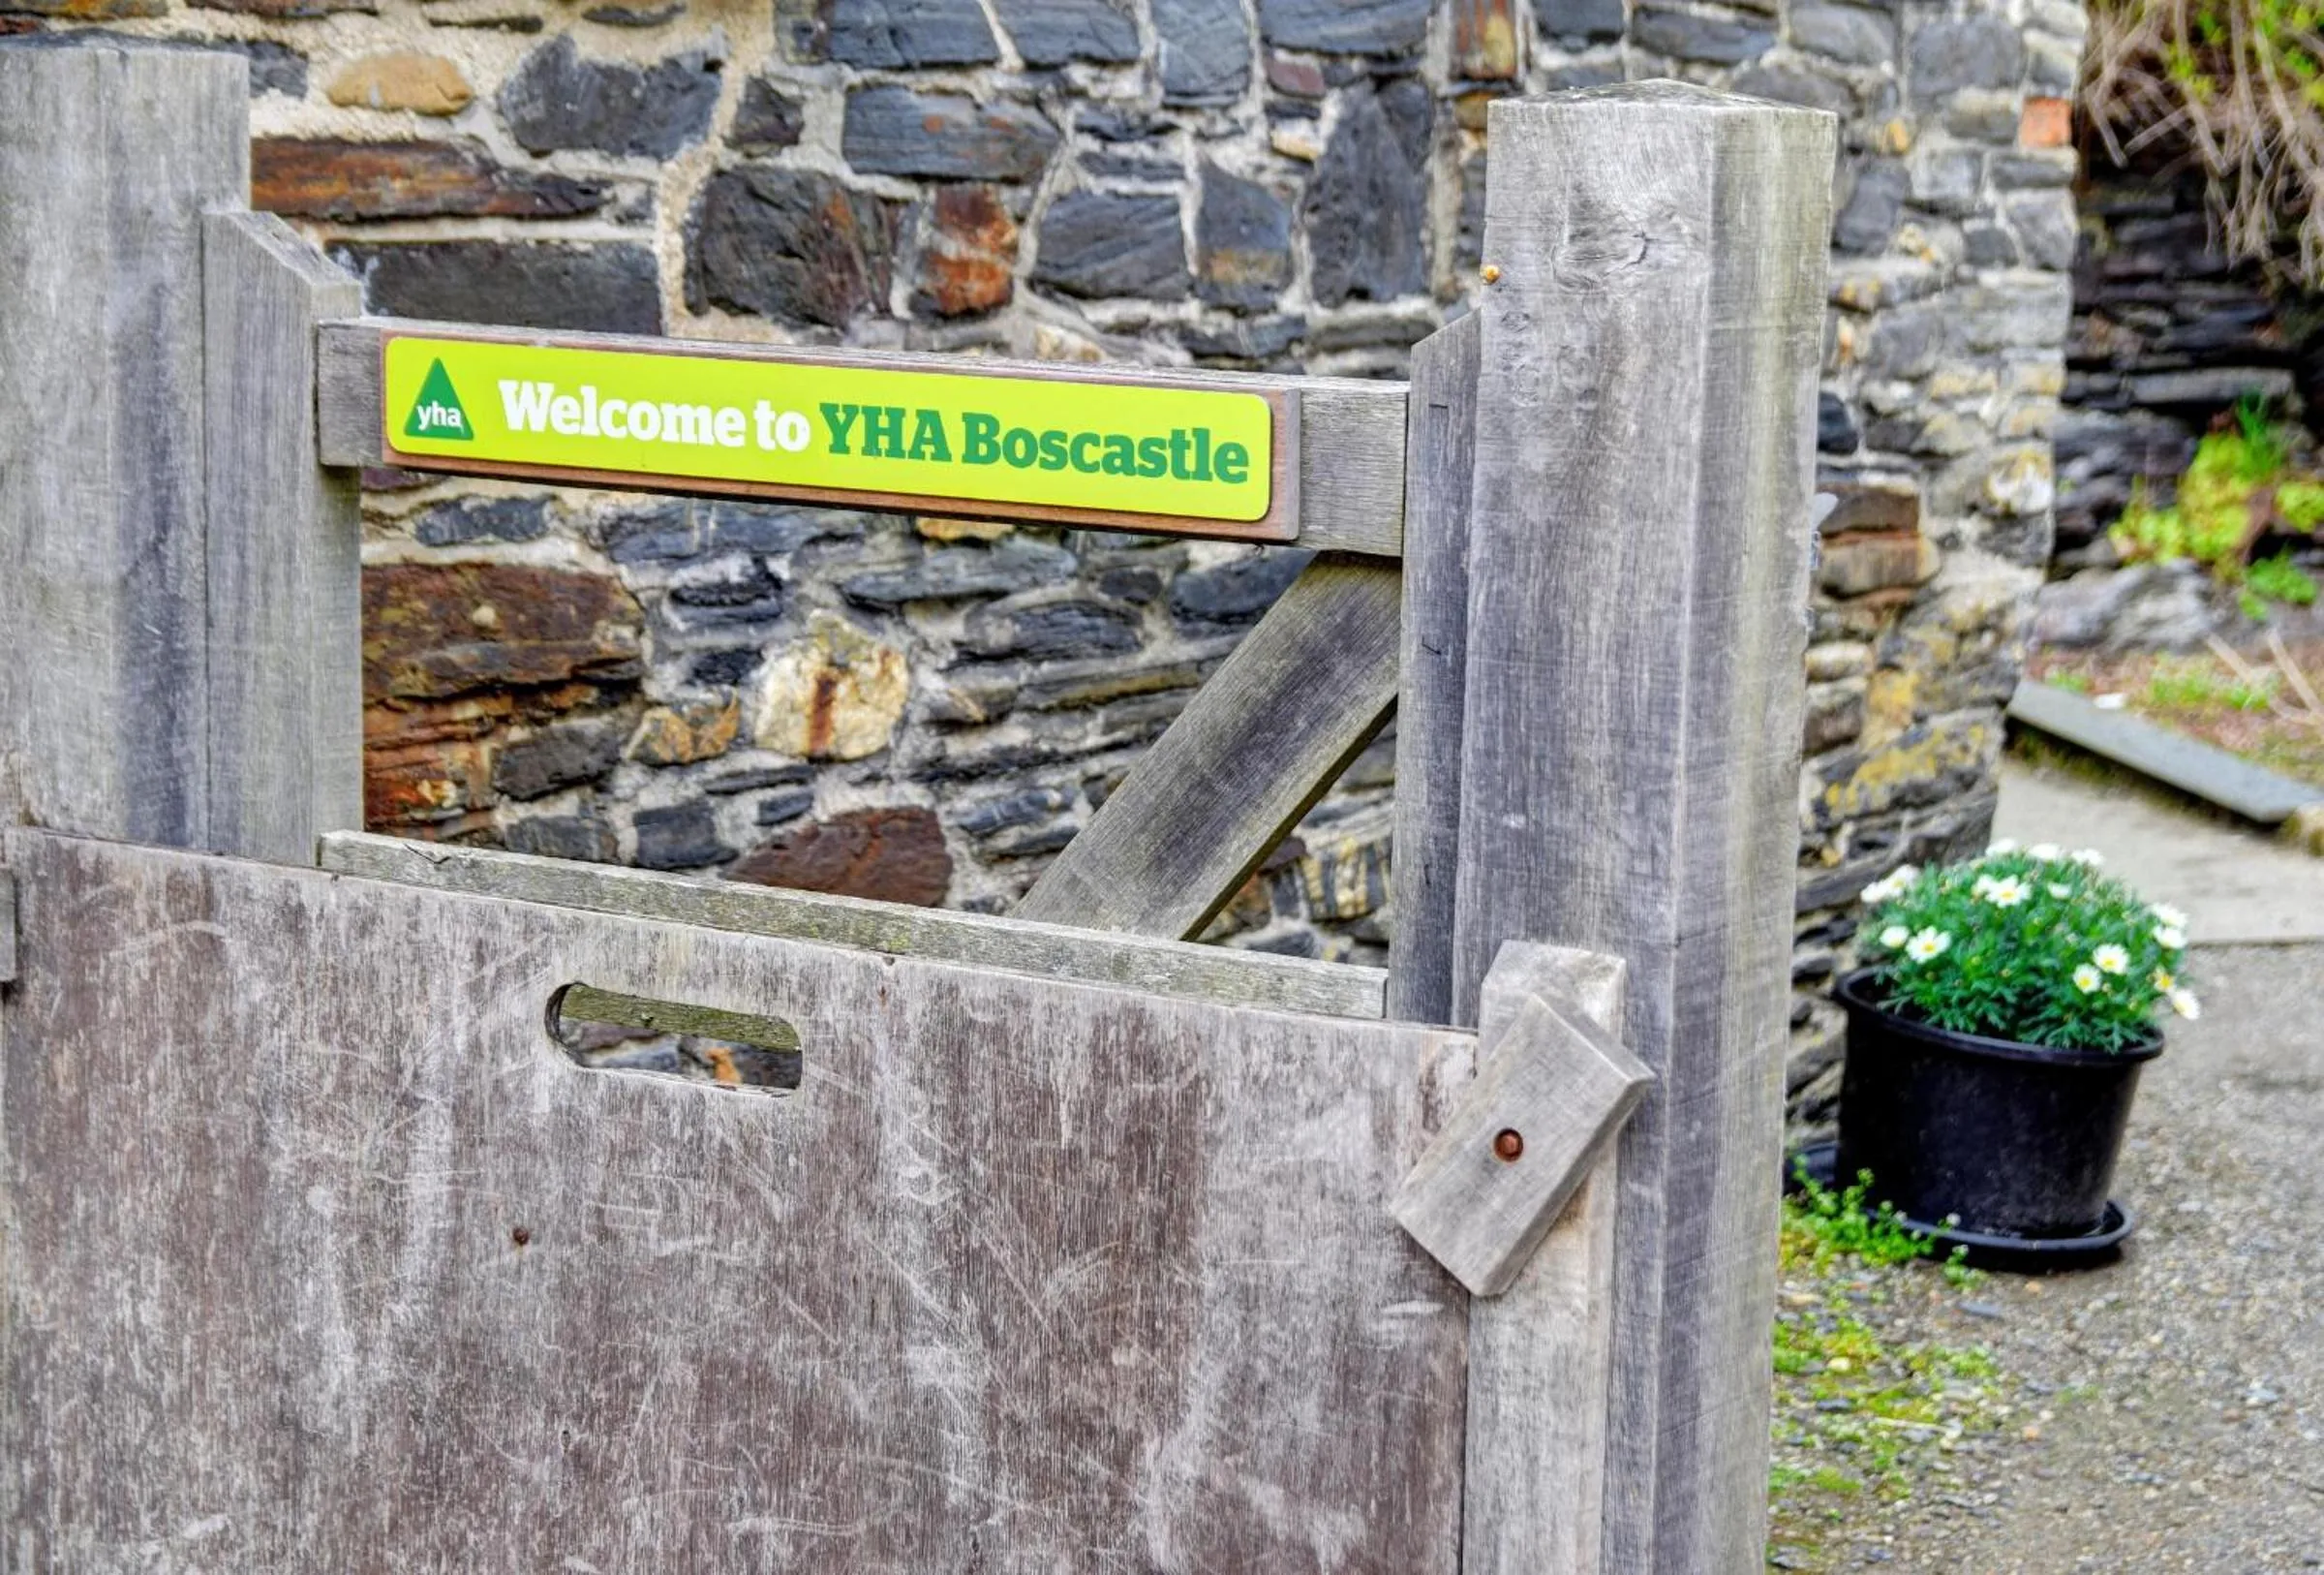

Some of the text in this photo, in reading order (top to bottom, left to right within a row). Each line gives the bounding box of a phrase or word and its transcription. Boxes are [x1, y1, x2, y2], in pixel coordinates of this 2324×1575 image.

[416, 400, 464, 434] yha
[498, 380, 1250, 484] Welcome to YHA Boscastle
